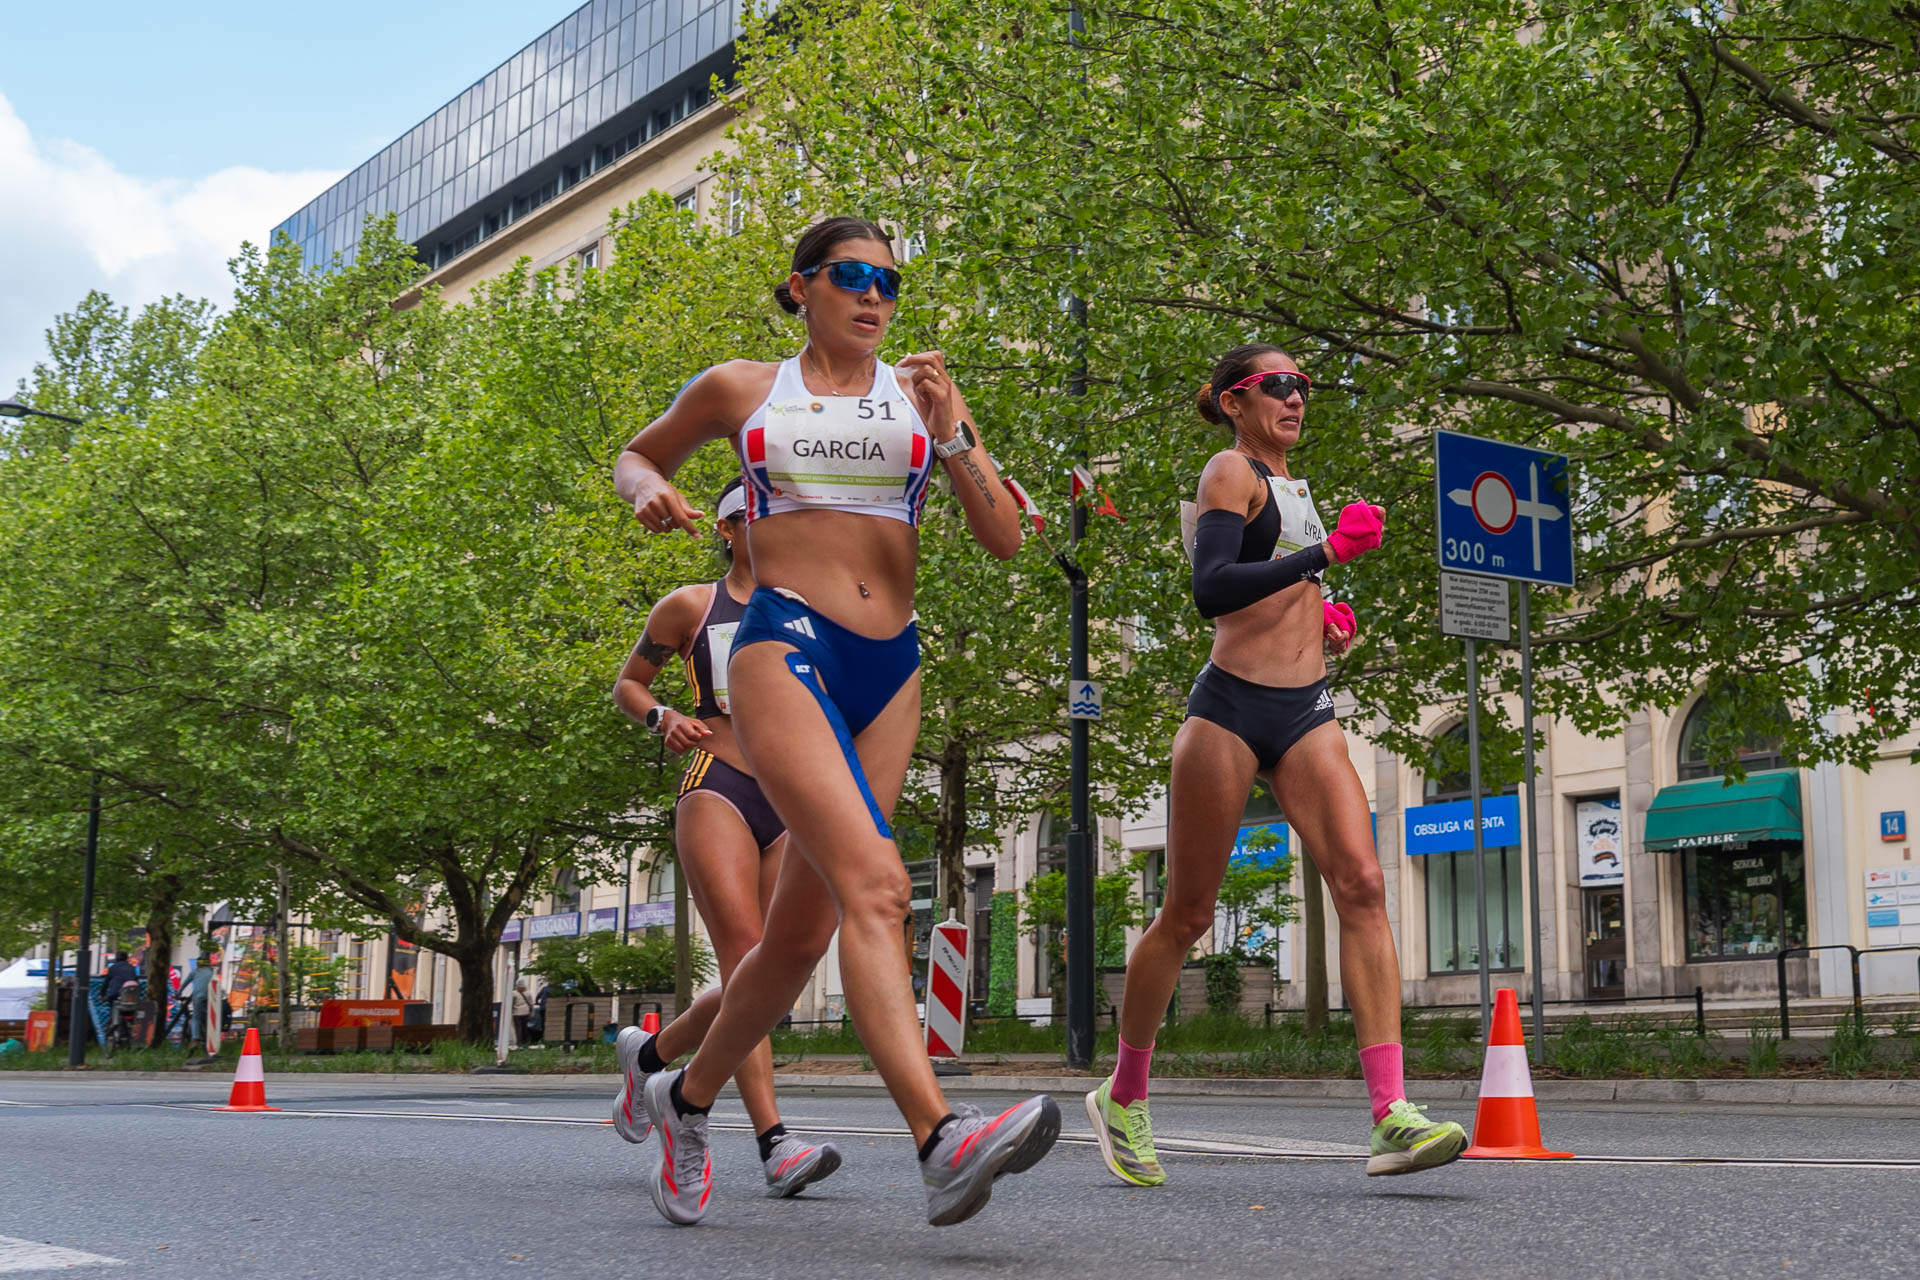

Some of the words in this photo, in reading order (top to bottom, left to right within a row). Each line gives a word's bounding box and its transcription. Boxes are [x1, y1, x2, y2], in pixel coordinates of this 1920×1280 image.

[857, 399, 896, 421] 51
[792, 437, 885, 461] GARCÍA
[1446, 538, 1485, 564] 300
[1492, 554, 1505, 568] m
[1413, 821, 1460, 836] OBSŁUGA
[1463, 816, 1505, 831] KLENTA
[1885, 818, 1899, 833] 14
[1746, 875, 1773, 887] BIURO
